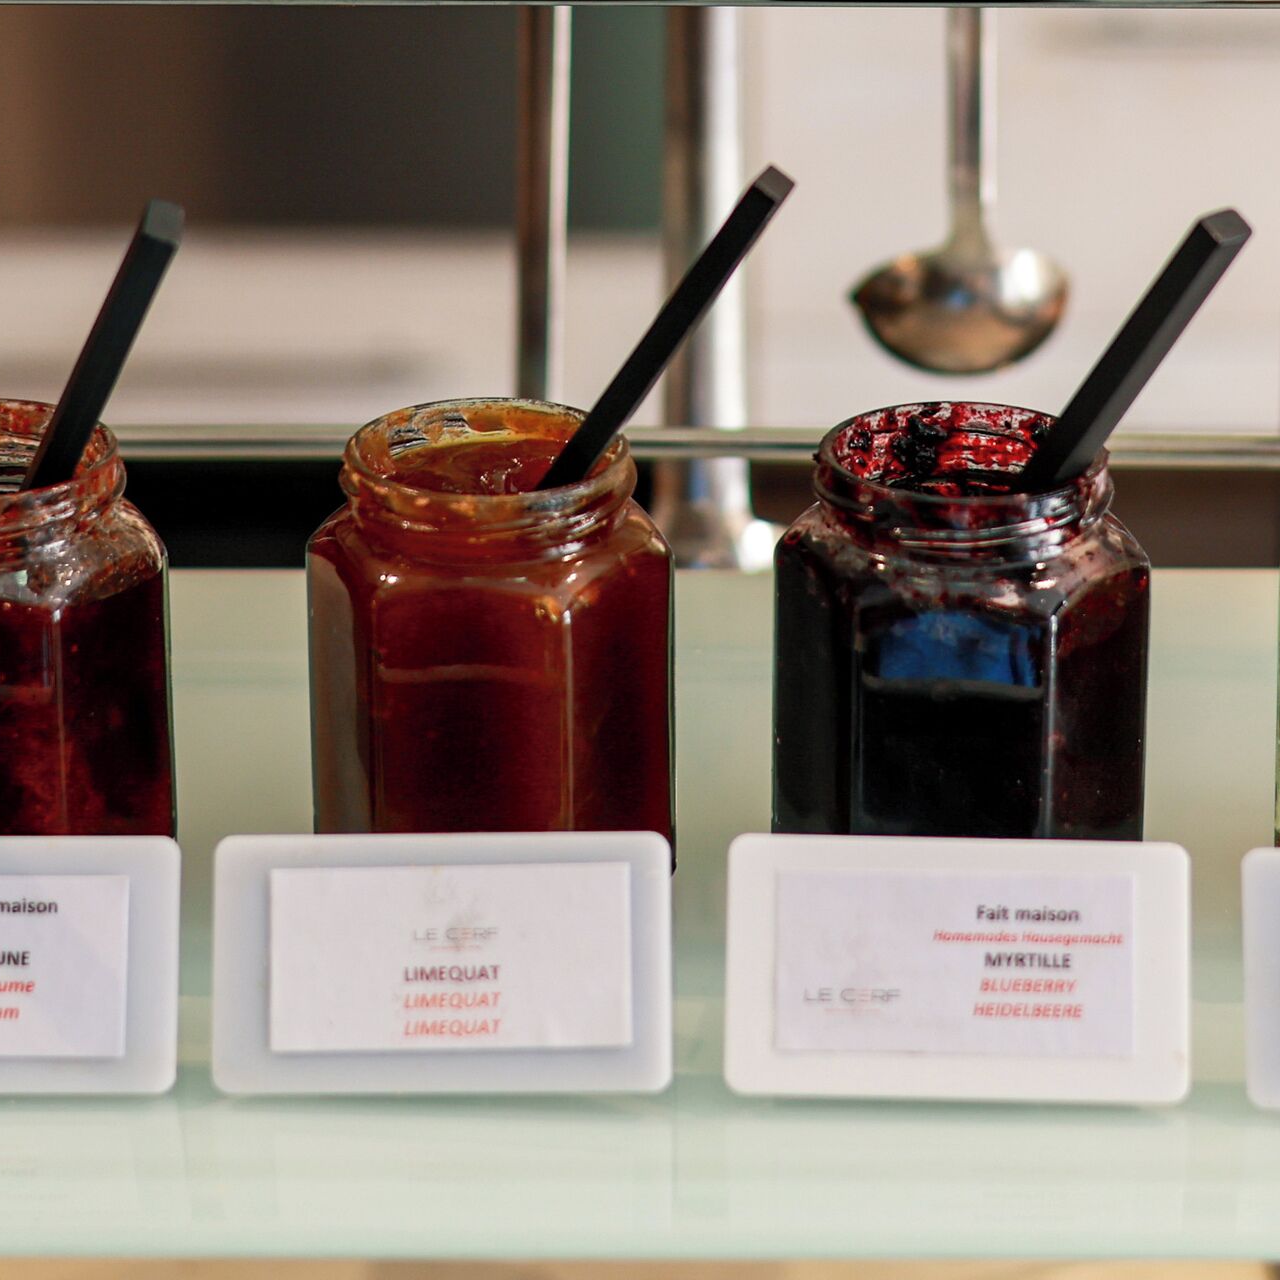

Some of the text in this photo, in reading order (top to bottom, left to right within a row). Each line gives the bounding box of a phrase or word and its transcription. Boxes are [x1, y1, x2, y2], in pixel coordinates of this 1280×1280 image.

[976, 905, 1080, 923] Fait maison
[413, 927, 499, 941] LE CERF
[984, 951, 1072, 969] MYRTILLE
[404, 964, 500, 983] LIMEQUAT
[979, 977, 1078, 994] BLUEBERRY
[403, 991, 501, 1010] LIMEQUAT
[803, 987, 901, 1003] LE CERF
[972, 1002, 1085, 1019] HEIDELBEERE
[403, 1018, 502, 1037] LIMEQUAT
